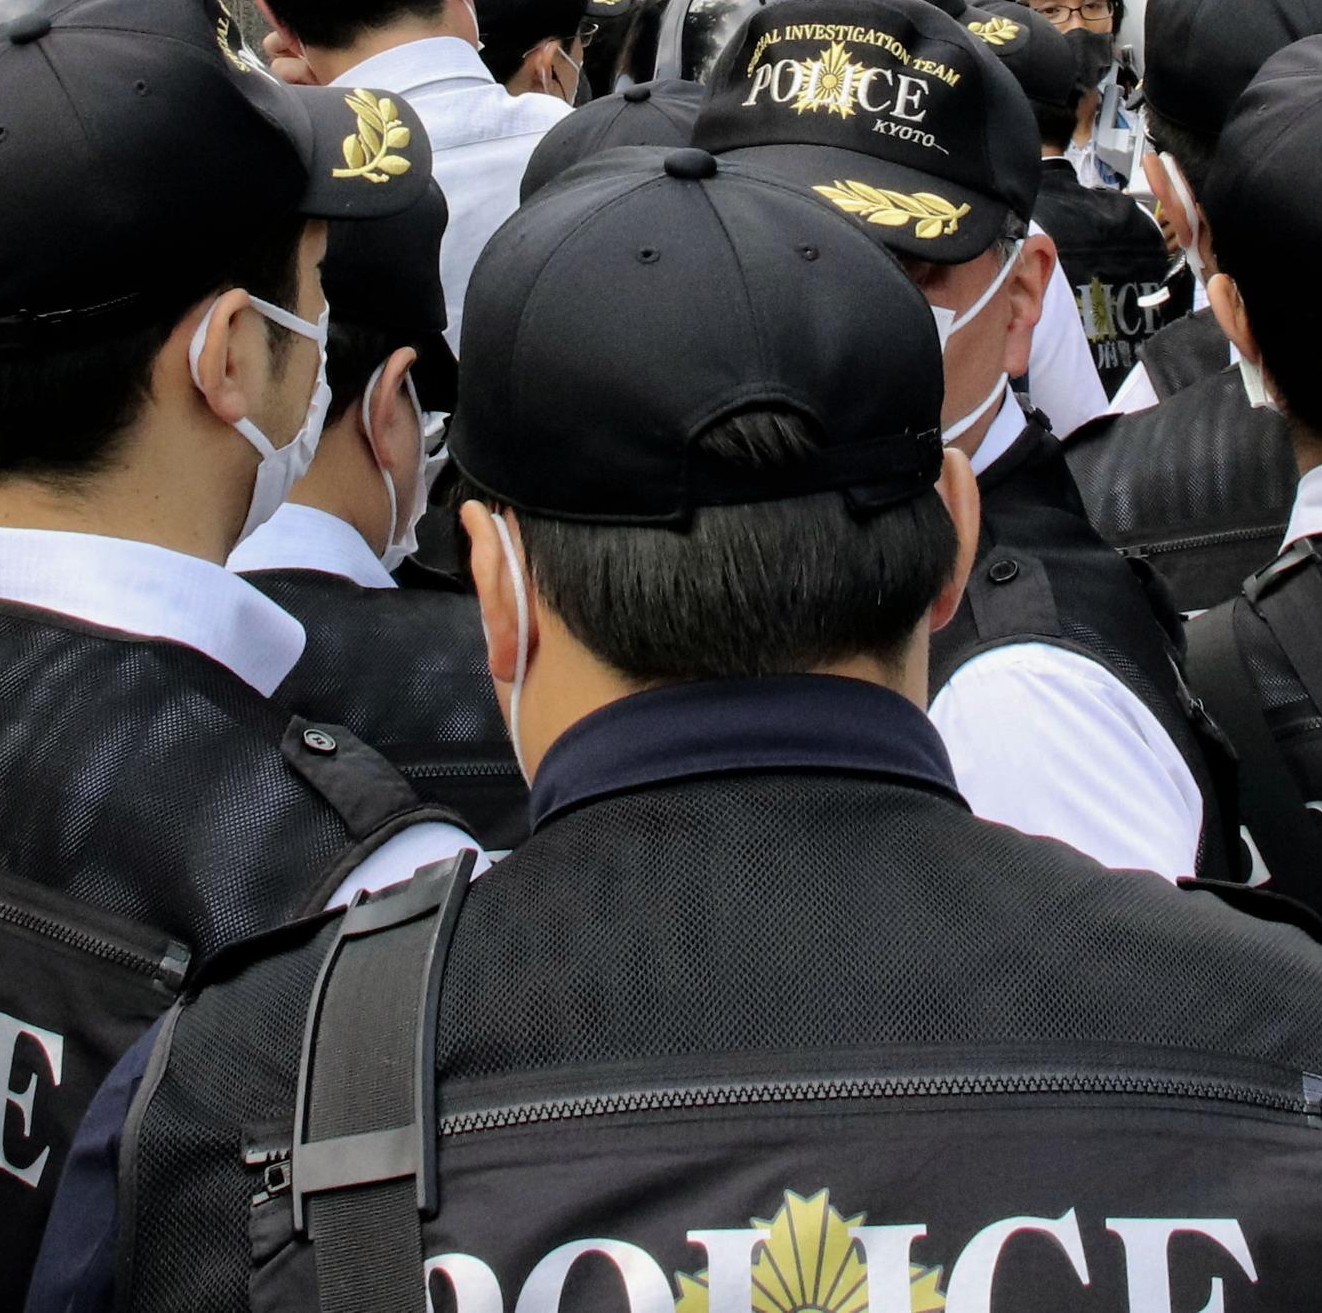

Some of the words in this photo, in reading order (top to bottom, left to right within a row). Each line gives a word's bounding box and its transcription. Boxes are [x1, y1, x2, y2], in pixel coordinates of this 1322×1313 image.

[784, 24, 912, 66] INVESTIGATION
[912, 58, 962, 88] TEAM
[740, 58, 930, 123] POLICE
[871, 118, 936, 147] KYOTO
